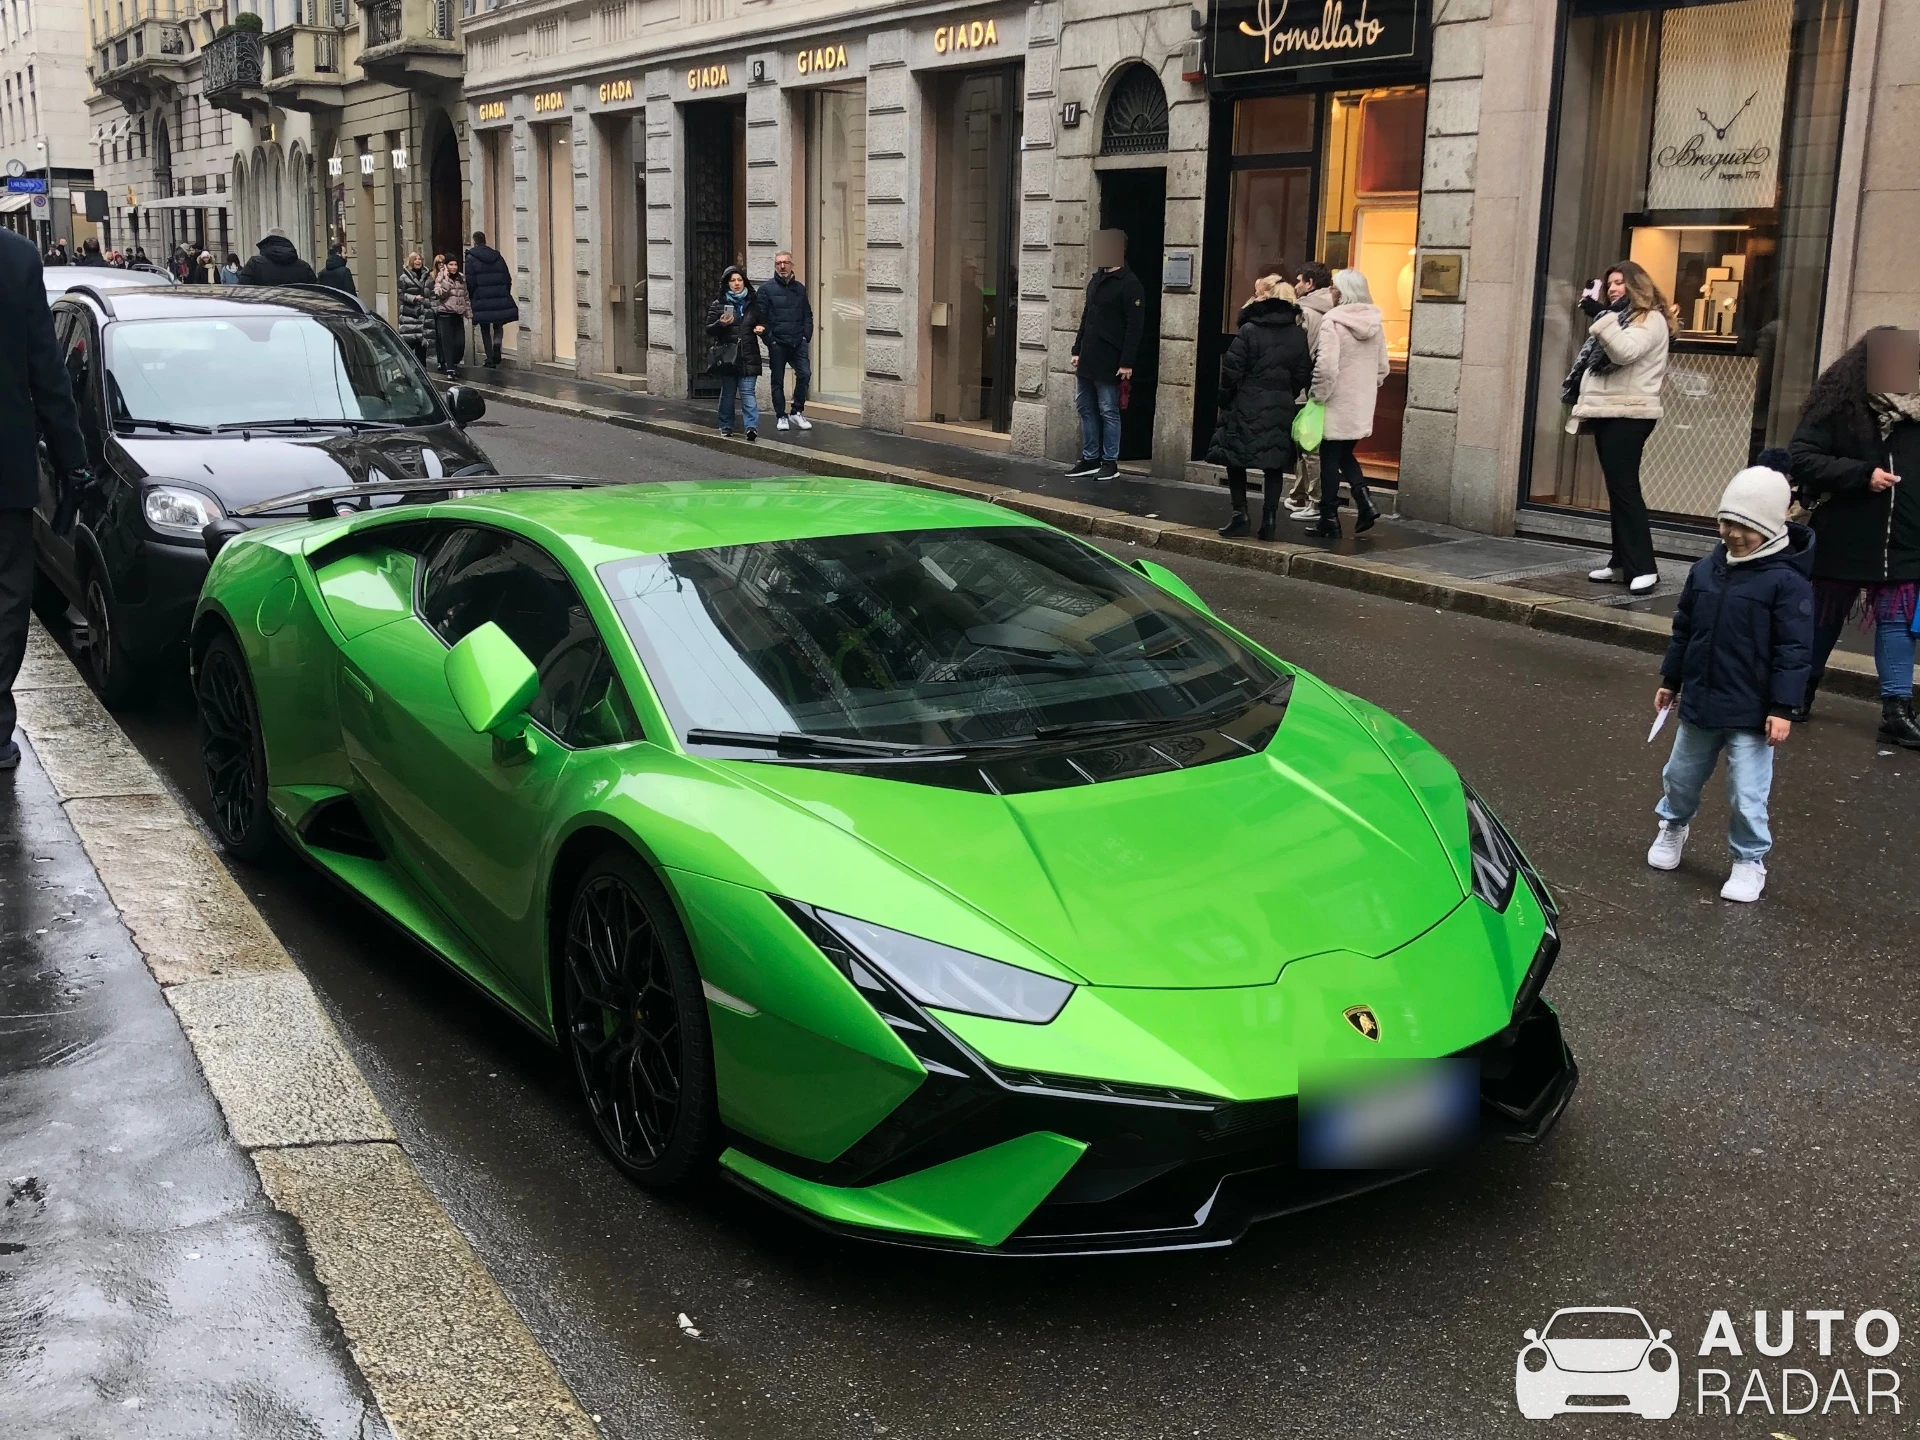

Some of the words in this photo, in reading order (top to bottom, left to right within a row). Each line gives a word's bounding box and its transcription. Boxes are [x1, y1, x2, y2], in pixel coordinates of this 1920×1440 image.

[934, 19, 998, 53] GIADA
[1239, 0, 1385, 64] Pomellato
[797, 44, 847, 73] GIADA
[687, 64, 729, 90] GIADA
[534, 92, 563, 112] GIADA
[599, 80, 633, 102] GIADA
[479, 101, 505, 120] GIADA
[1064, 103, 1077, 122] 17
[1657, 132, 1770, 180] Breguet
